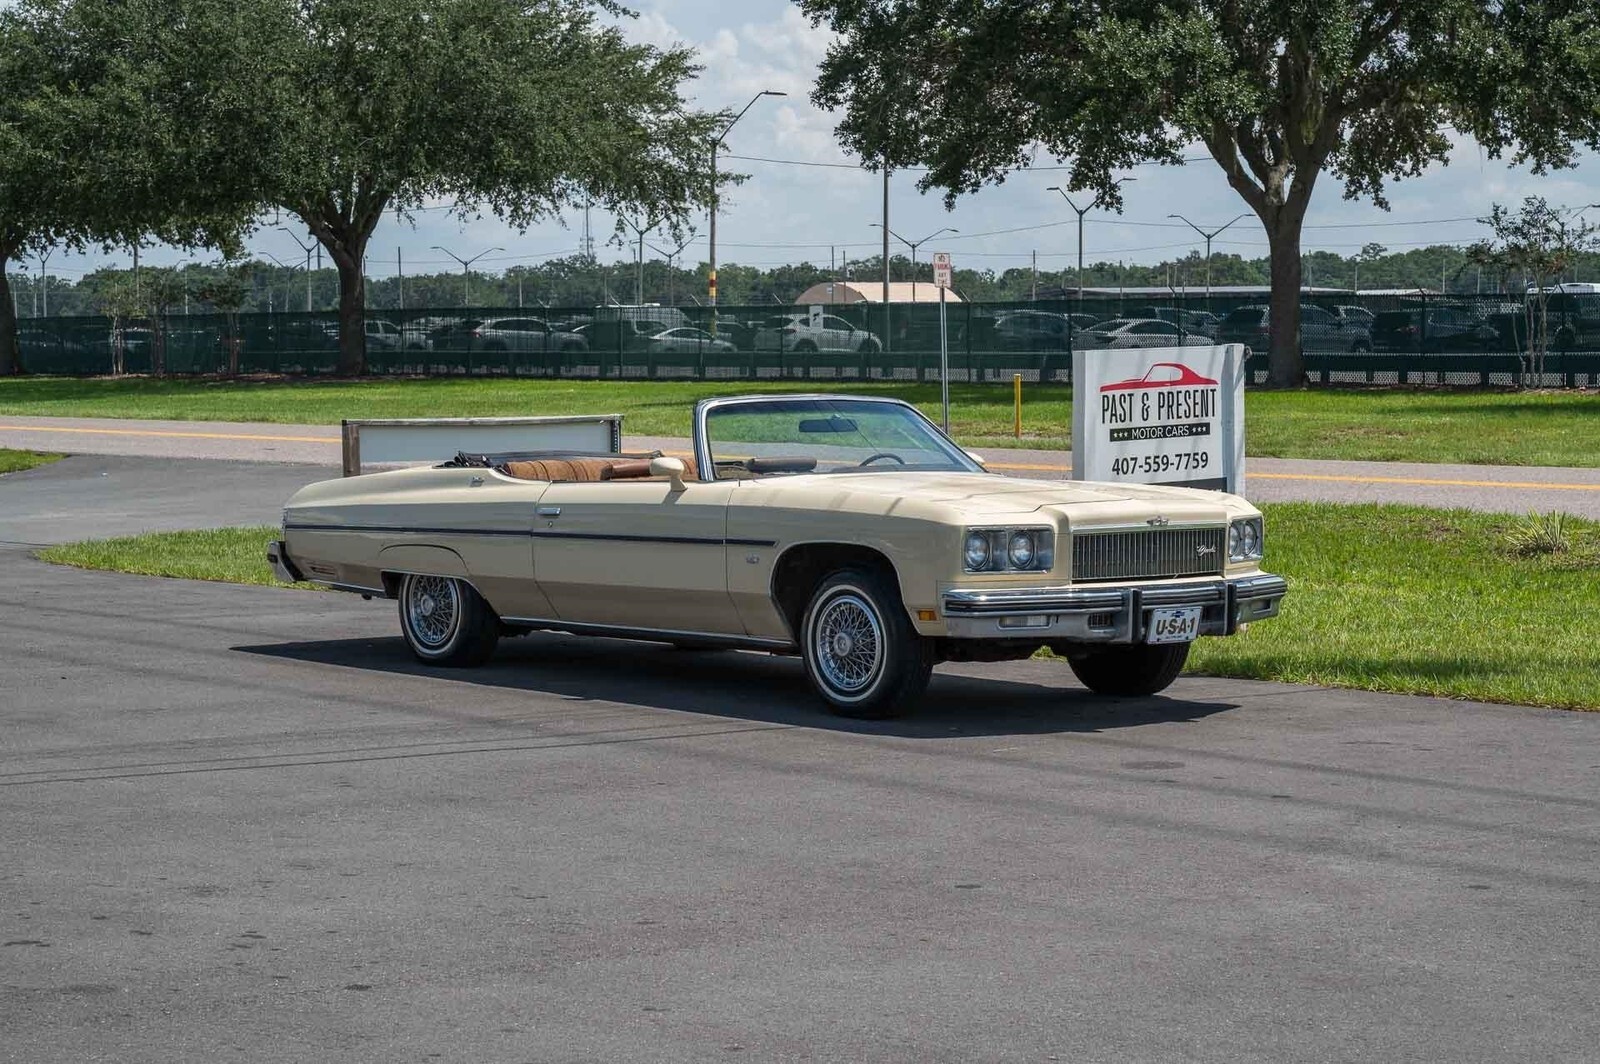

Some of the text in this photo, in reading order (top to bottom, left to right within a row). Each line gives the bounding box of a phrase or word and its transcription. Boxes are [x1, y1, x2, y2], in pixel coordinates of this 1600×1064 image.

[1101, 388, 1217, 424] PAST & PRESENT
[1131, 425, 1189, 440] MOTOR CARS
[1111, 451, 1209, 476] 407-559-7759
